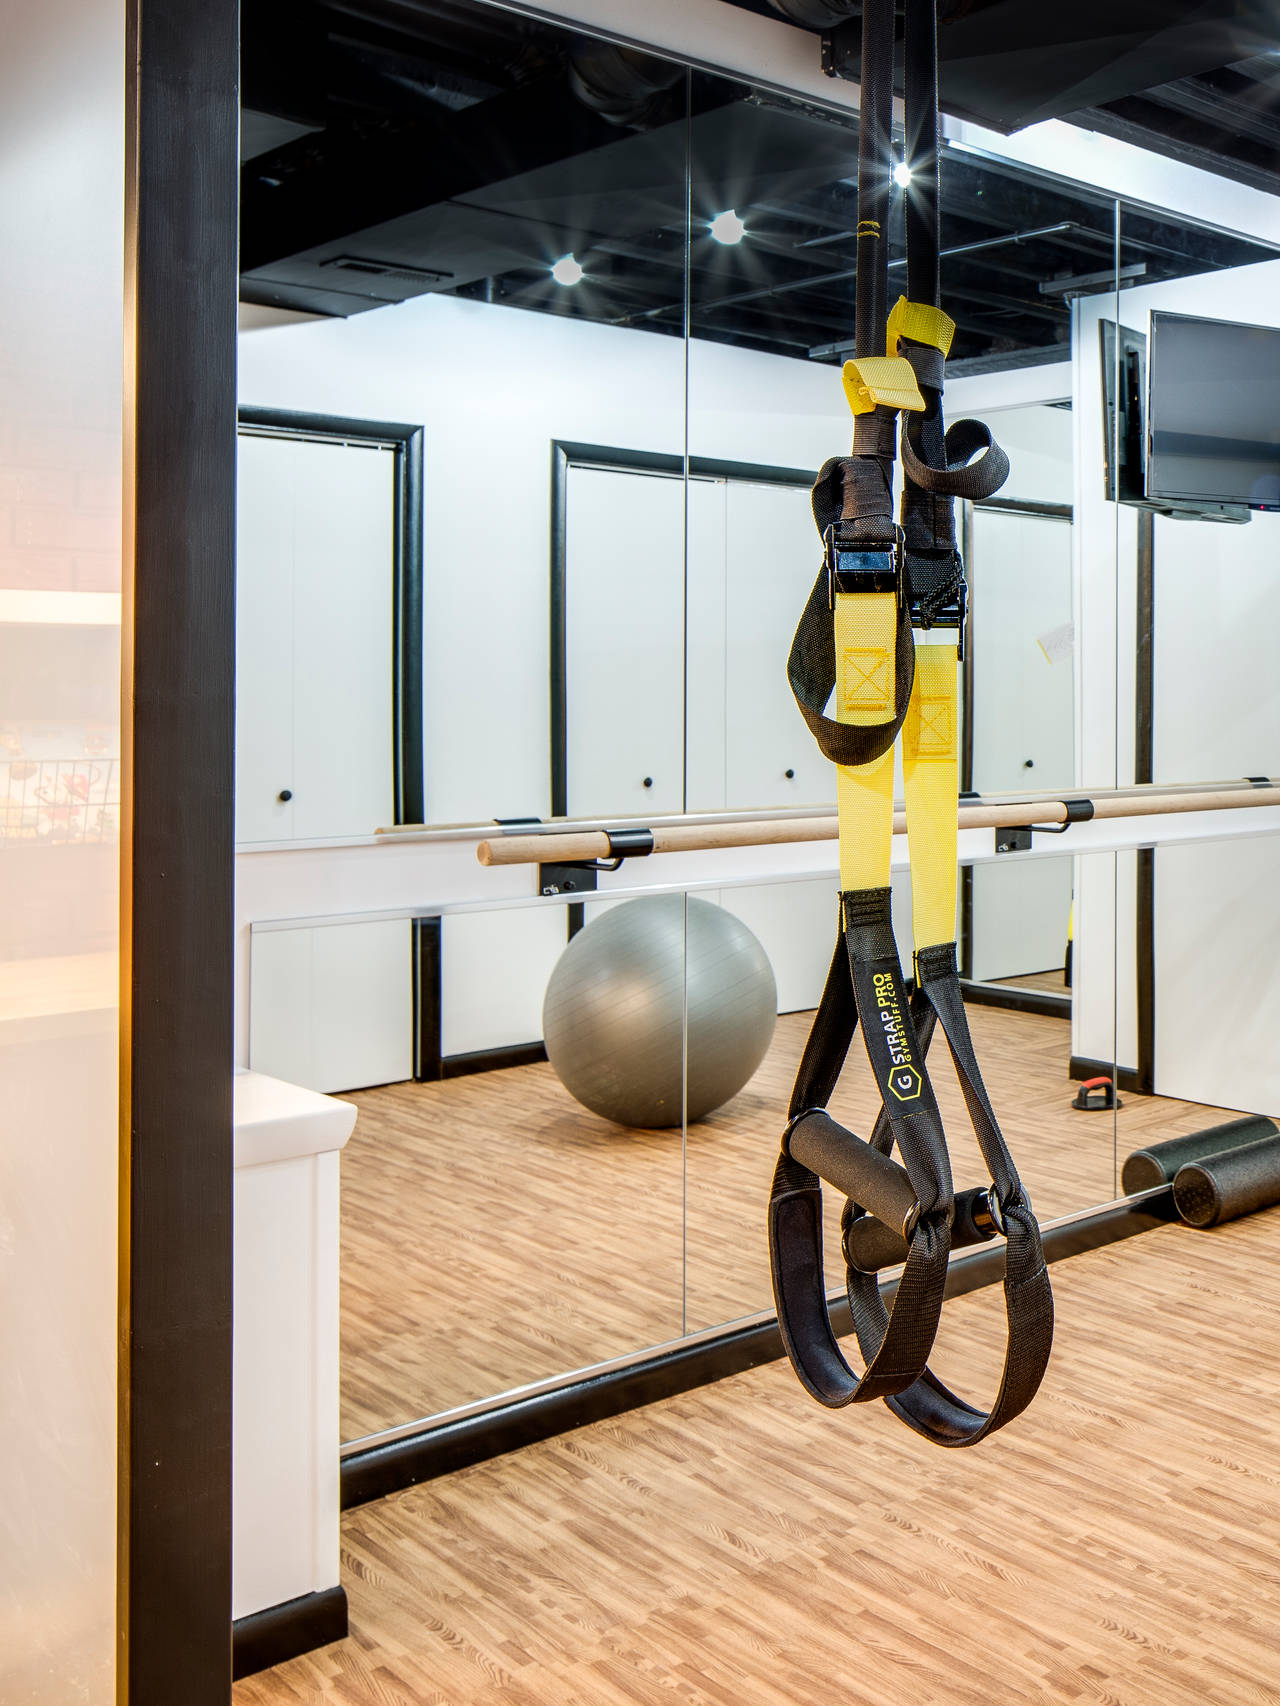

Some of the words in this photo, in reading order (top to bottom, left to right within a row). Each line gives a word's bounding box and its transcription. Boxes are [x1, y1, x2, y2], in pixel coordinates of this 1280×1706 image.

[873, 973, 891, 1007] PRO
[880, 1011, 905, 1065] STRAP
[883, 972, 912, 1062] GYMSTUFF.COM
[897, 1074, 912, 1090] G
